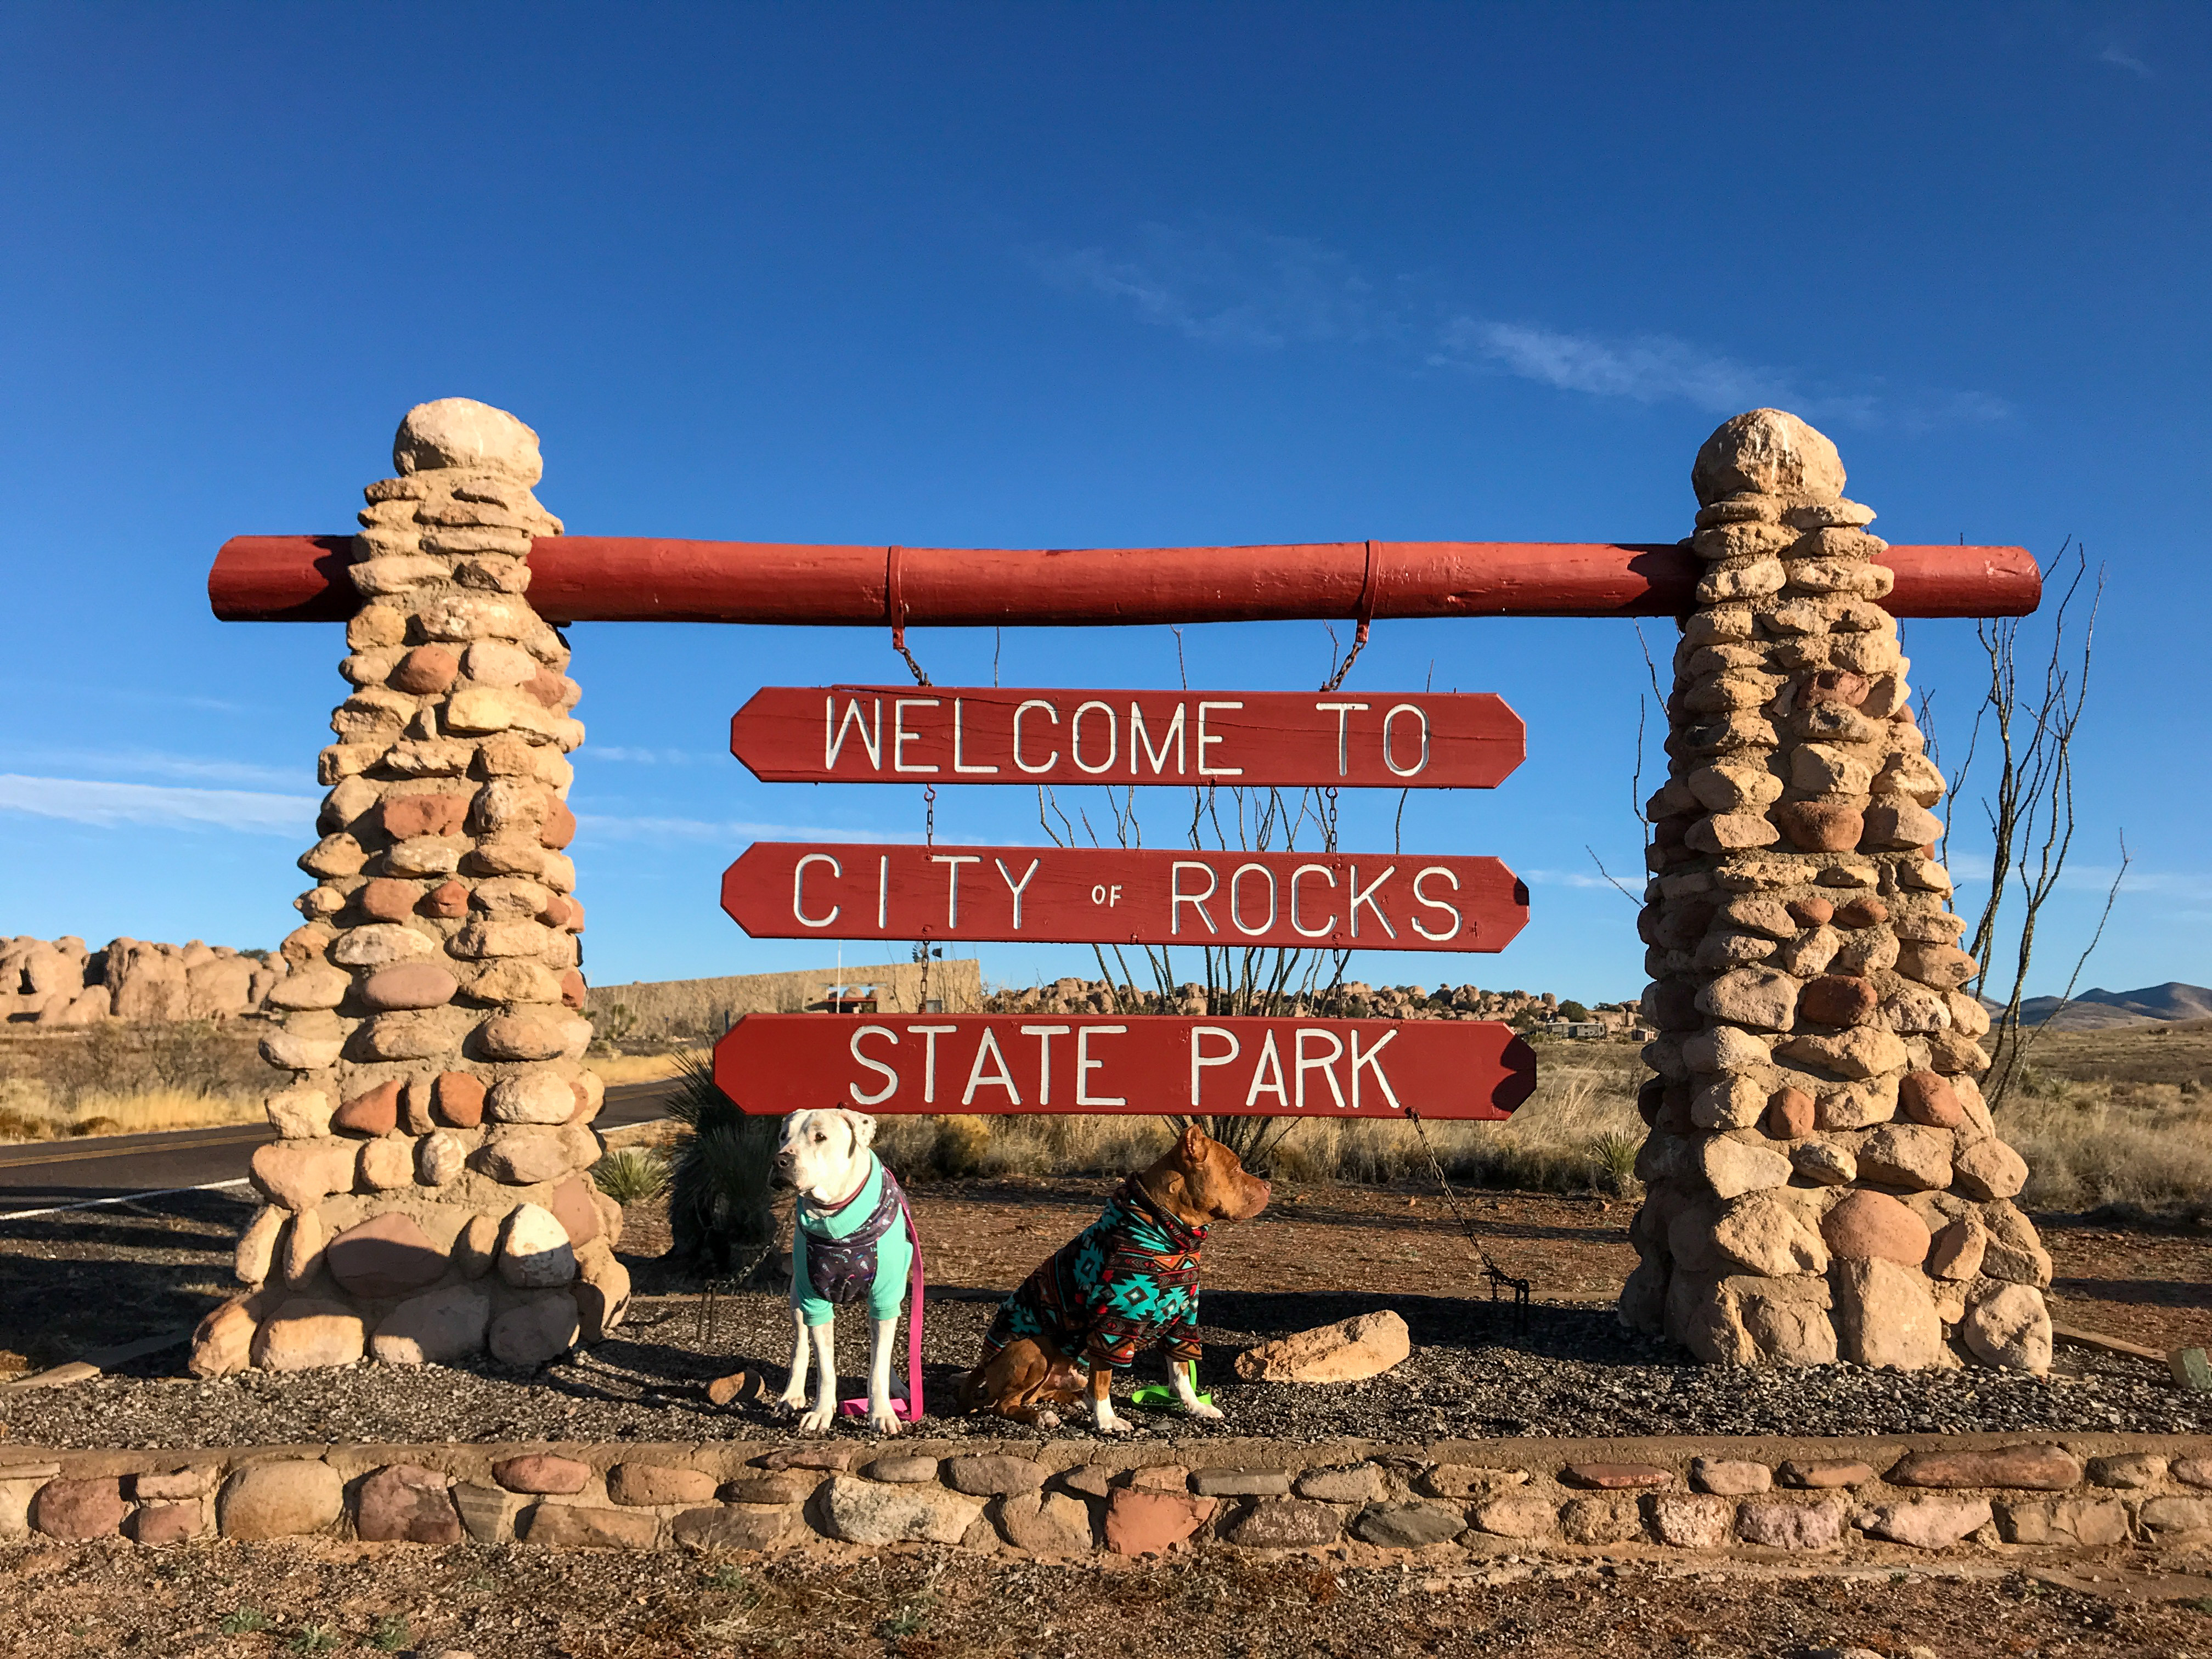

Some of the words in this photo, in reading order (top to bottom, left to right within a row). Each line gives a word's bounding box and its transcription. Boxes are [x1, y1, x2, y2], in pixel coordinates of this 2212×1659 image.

[826, 696, 1244, 775] WELCOME
[1316, 702, 1429, 777] TO
[793, 853, 1040, 930] CITY
[1091, 884, 1122, 908] OF
[1171, 861, 1463, 941] ROCKS
[849, 1025, 1128, 1106] STATE
[1191, 1026, 1400, 1108] PARK
